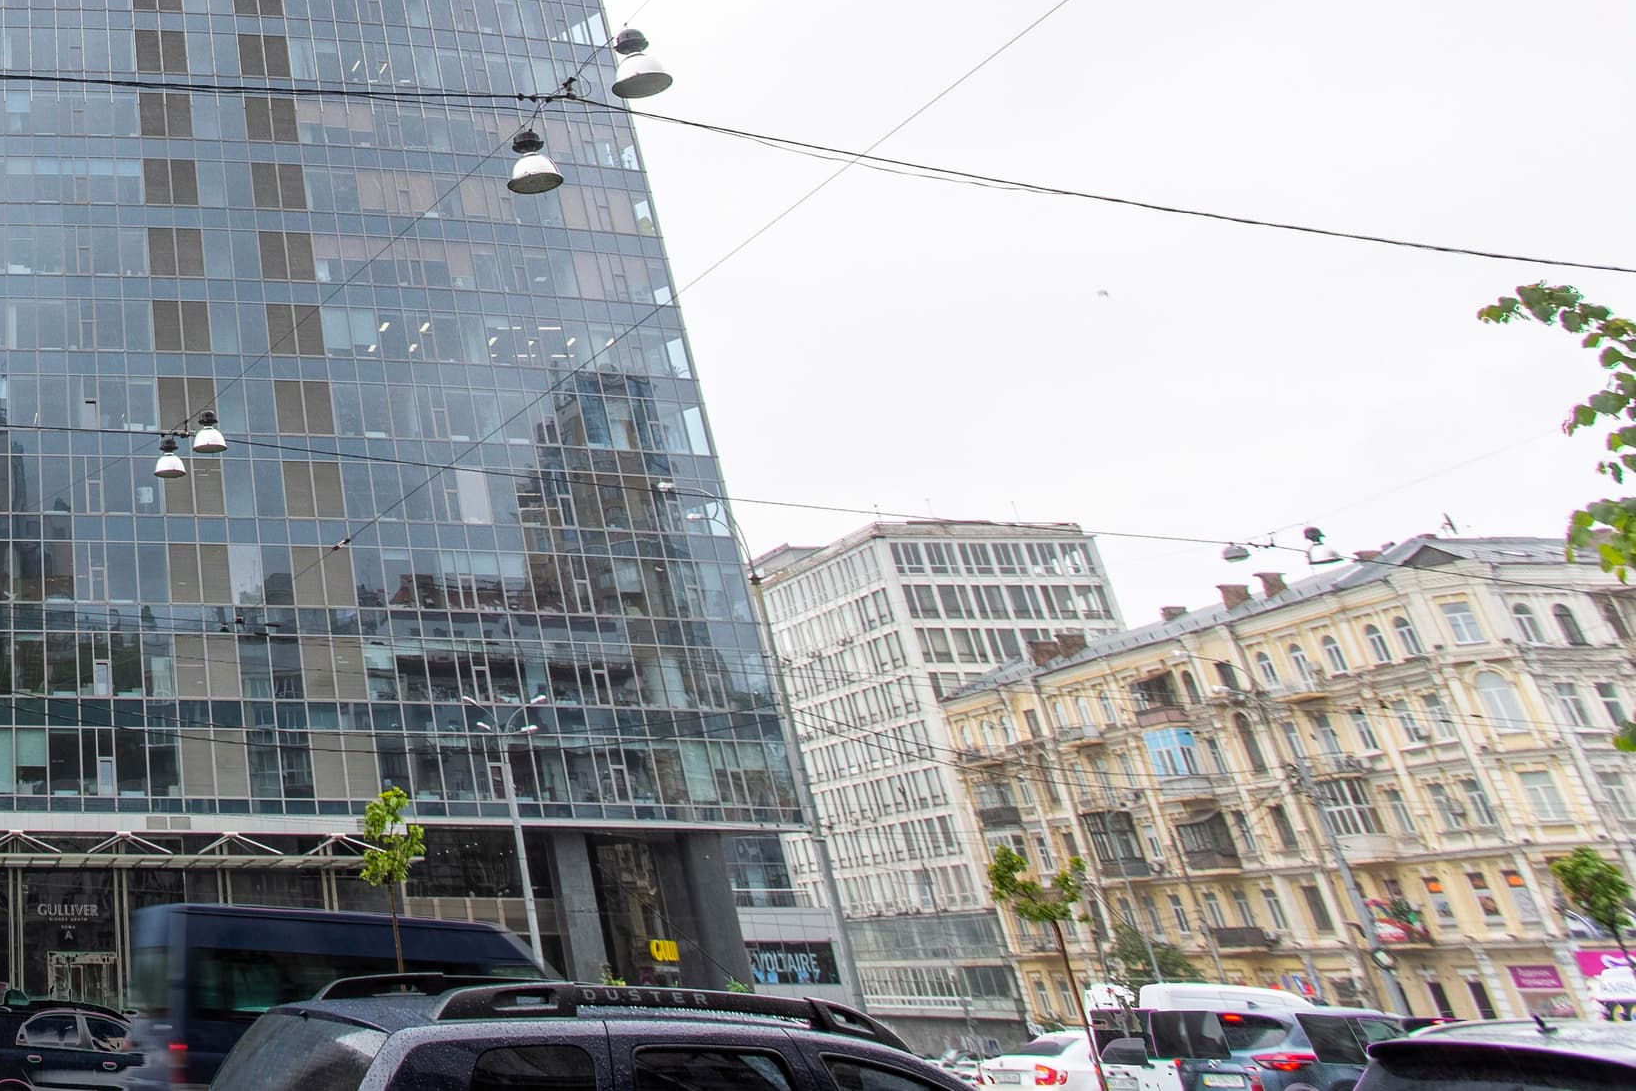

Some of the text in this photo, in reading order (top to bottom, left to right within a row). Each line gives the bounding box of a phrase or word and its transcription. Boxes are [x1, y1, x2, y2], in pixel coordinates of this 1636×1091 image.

[37, 903, 99, 916] GULLIVER
[64, 930, 73, 940] A
[582, 988, 708, 1005] DUSTER
